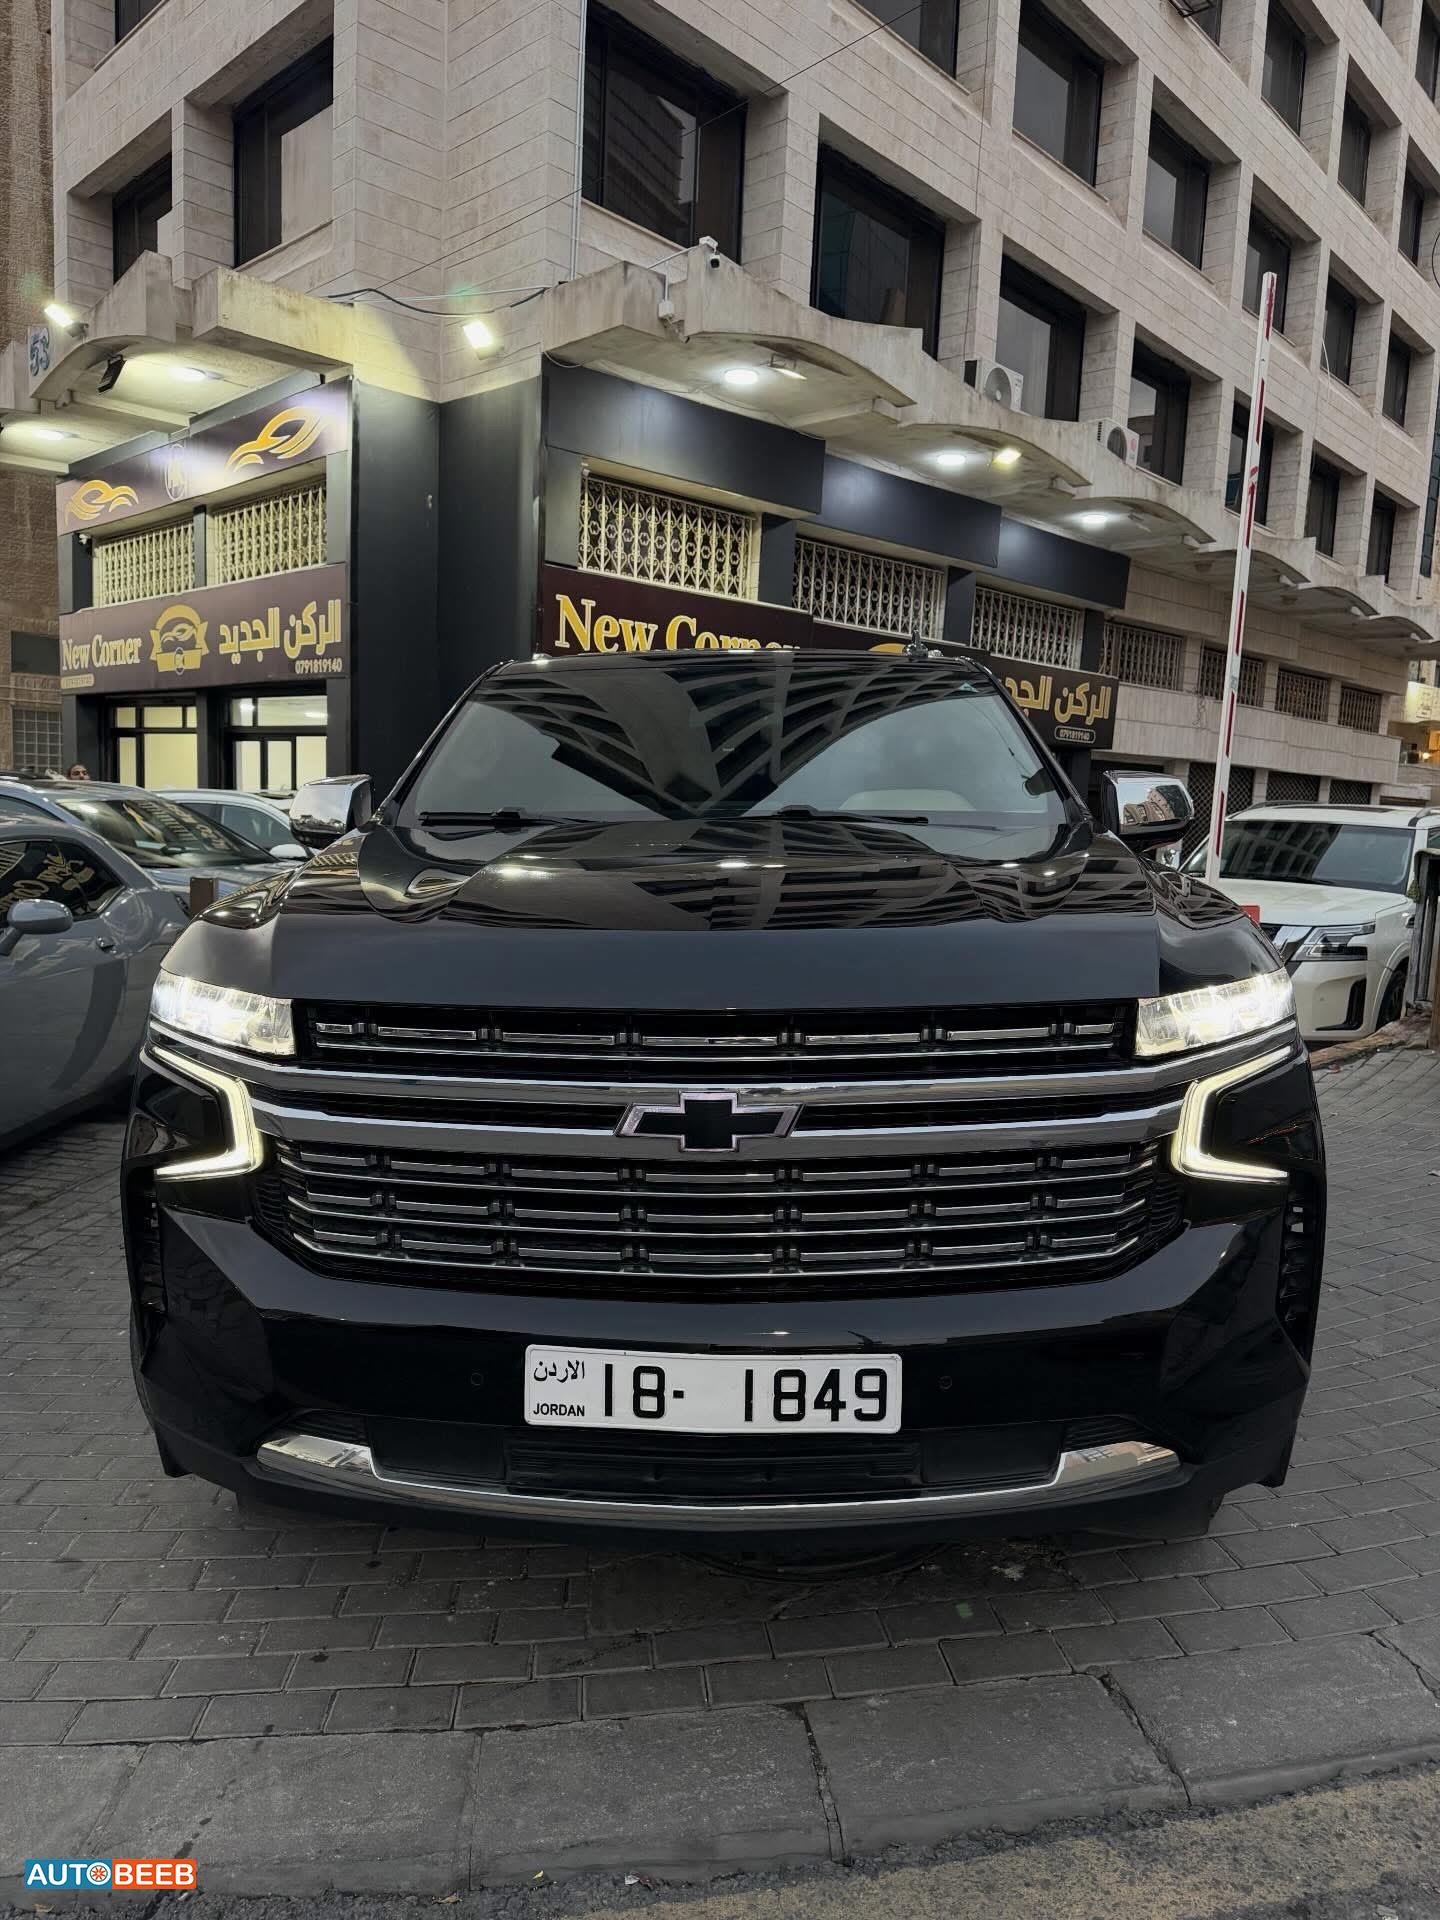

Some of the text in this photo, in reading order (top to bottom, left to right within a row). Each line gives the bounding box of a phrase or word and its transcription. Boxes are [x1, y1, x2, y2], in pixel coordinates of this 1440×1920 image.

[219, 599, 342, 664] الركن الجديد
[555, 594, 659, 653] New
[61, 634, 142, 671] New Corner
[1005, 675, 1112, 725] الركن الجد
[533, 1359, 585, 1383] الاردن
[743, 1368, 888, 1423] 1849
[533, 1402, 585, 1417] JORDAN
